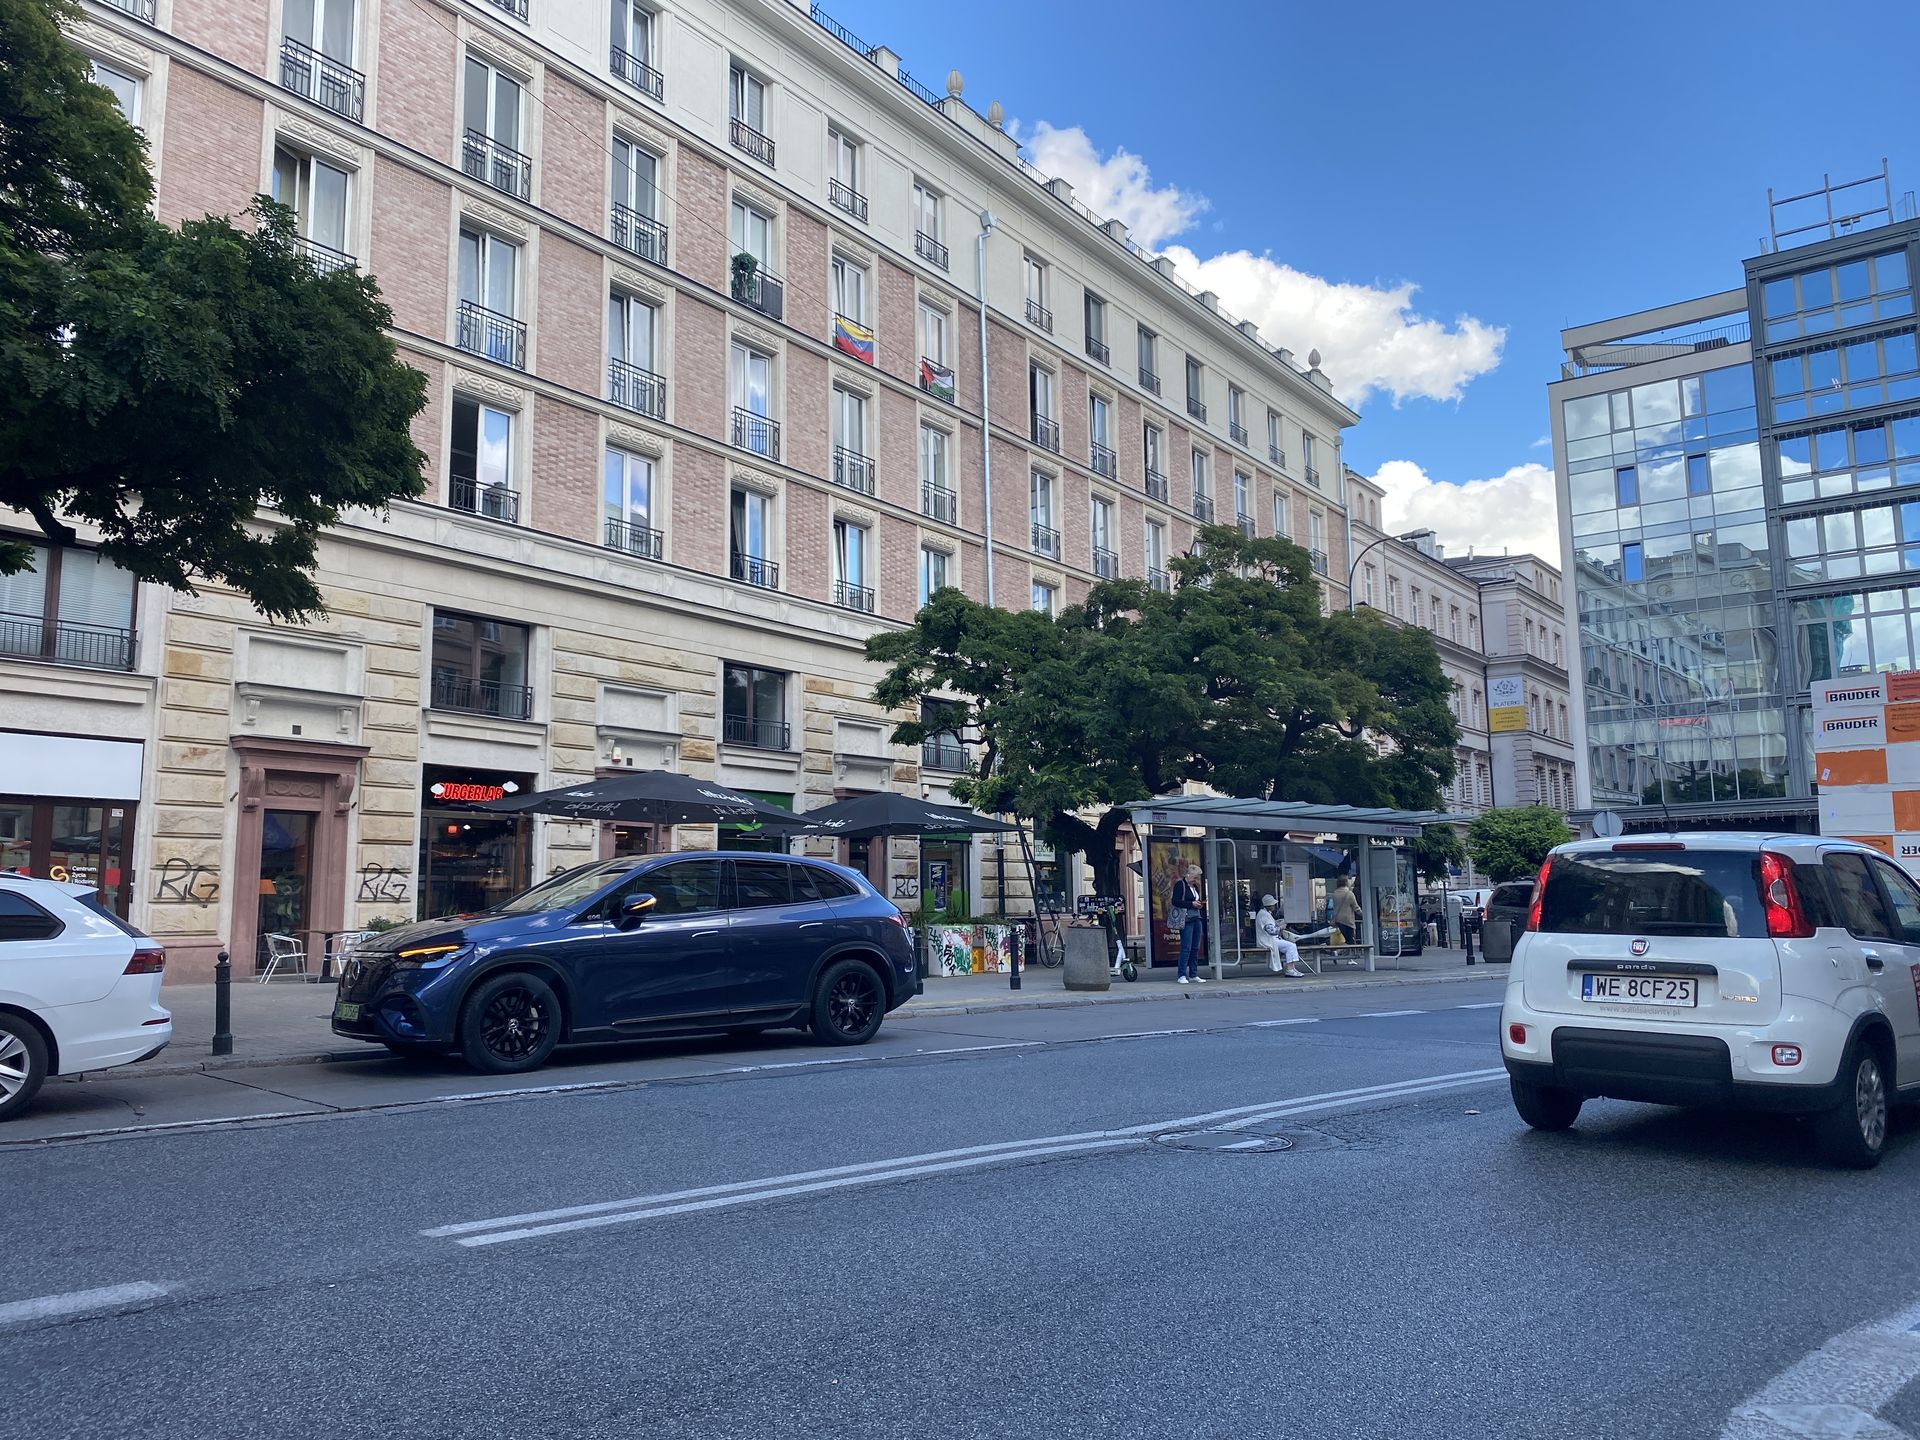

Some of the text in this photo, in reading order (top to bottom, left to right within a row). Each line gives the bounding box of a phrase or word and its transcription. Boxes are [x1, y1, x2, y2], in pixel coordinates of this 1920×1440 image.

[1830, 690, 1880, 702] BAUDER
[1827, 720, 1877, 731] BAUDER
[1901, 845, 1920, 855] ER
[1632, 941, 1646, 951] FIAT
[1597, 978, 1690, 1000] WE 8CF25
